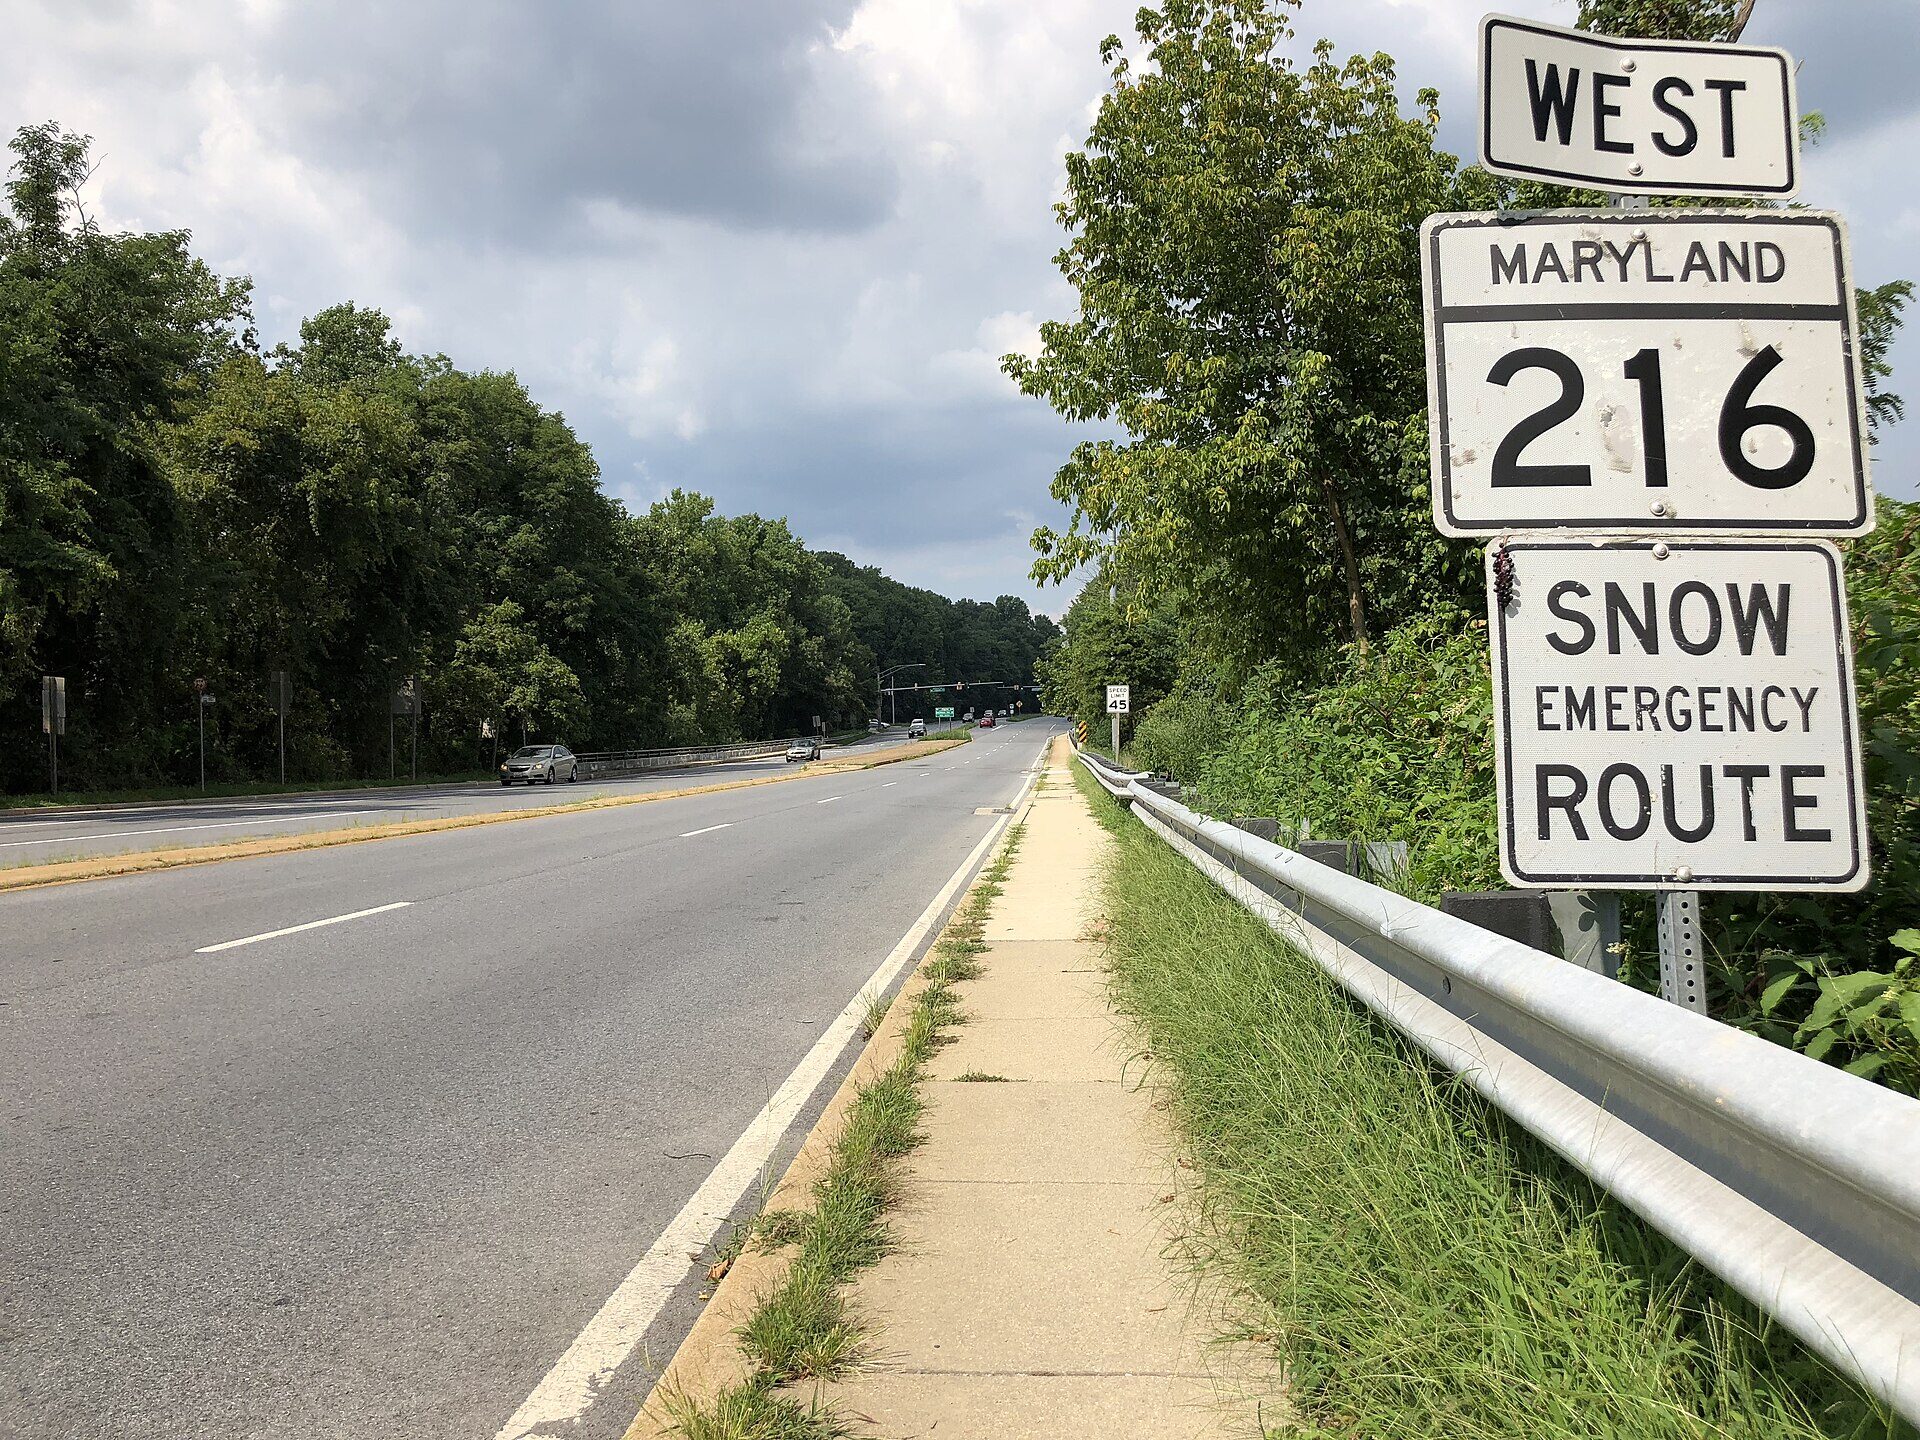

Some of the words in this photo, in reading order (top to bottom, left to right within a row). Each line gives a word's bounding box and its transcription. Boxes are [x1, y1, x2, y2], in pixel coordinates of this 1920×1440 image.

[1525, 59, 1747, 158] WEST
[1490, 241, 1786, 284] MARYLAND
[1486, 344, 1816, 489] 216
[1545, 580, 1790, 656] SNOW
[1108, 700, 1127, 710] 45
[1536, 685, 1819, 733] EMERGENCY
[1535, 762, 1832, 843] ROUTE
